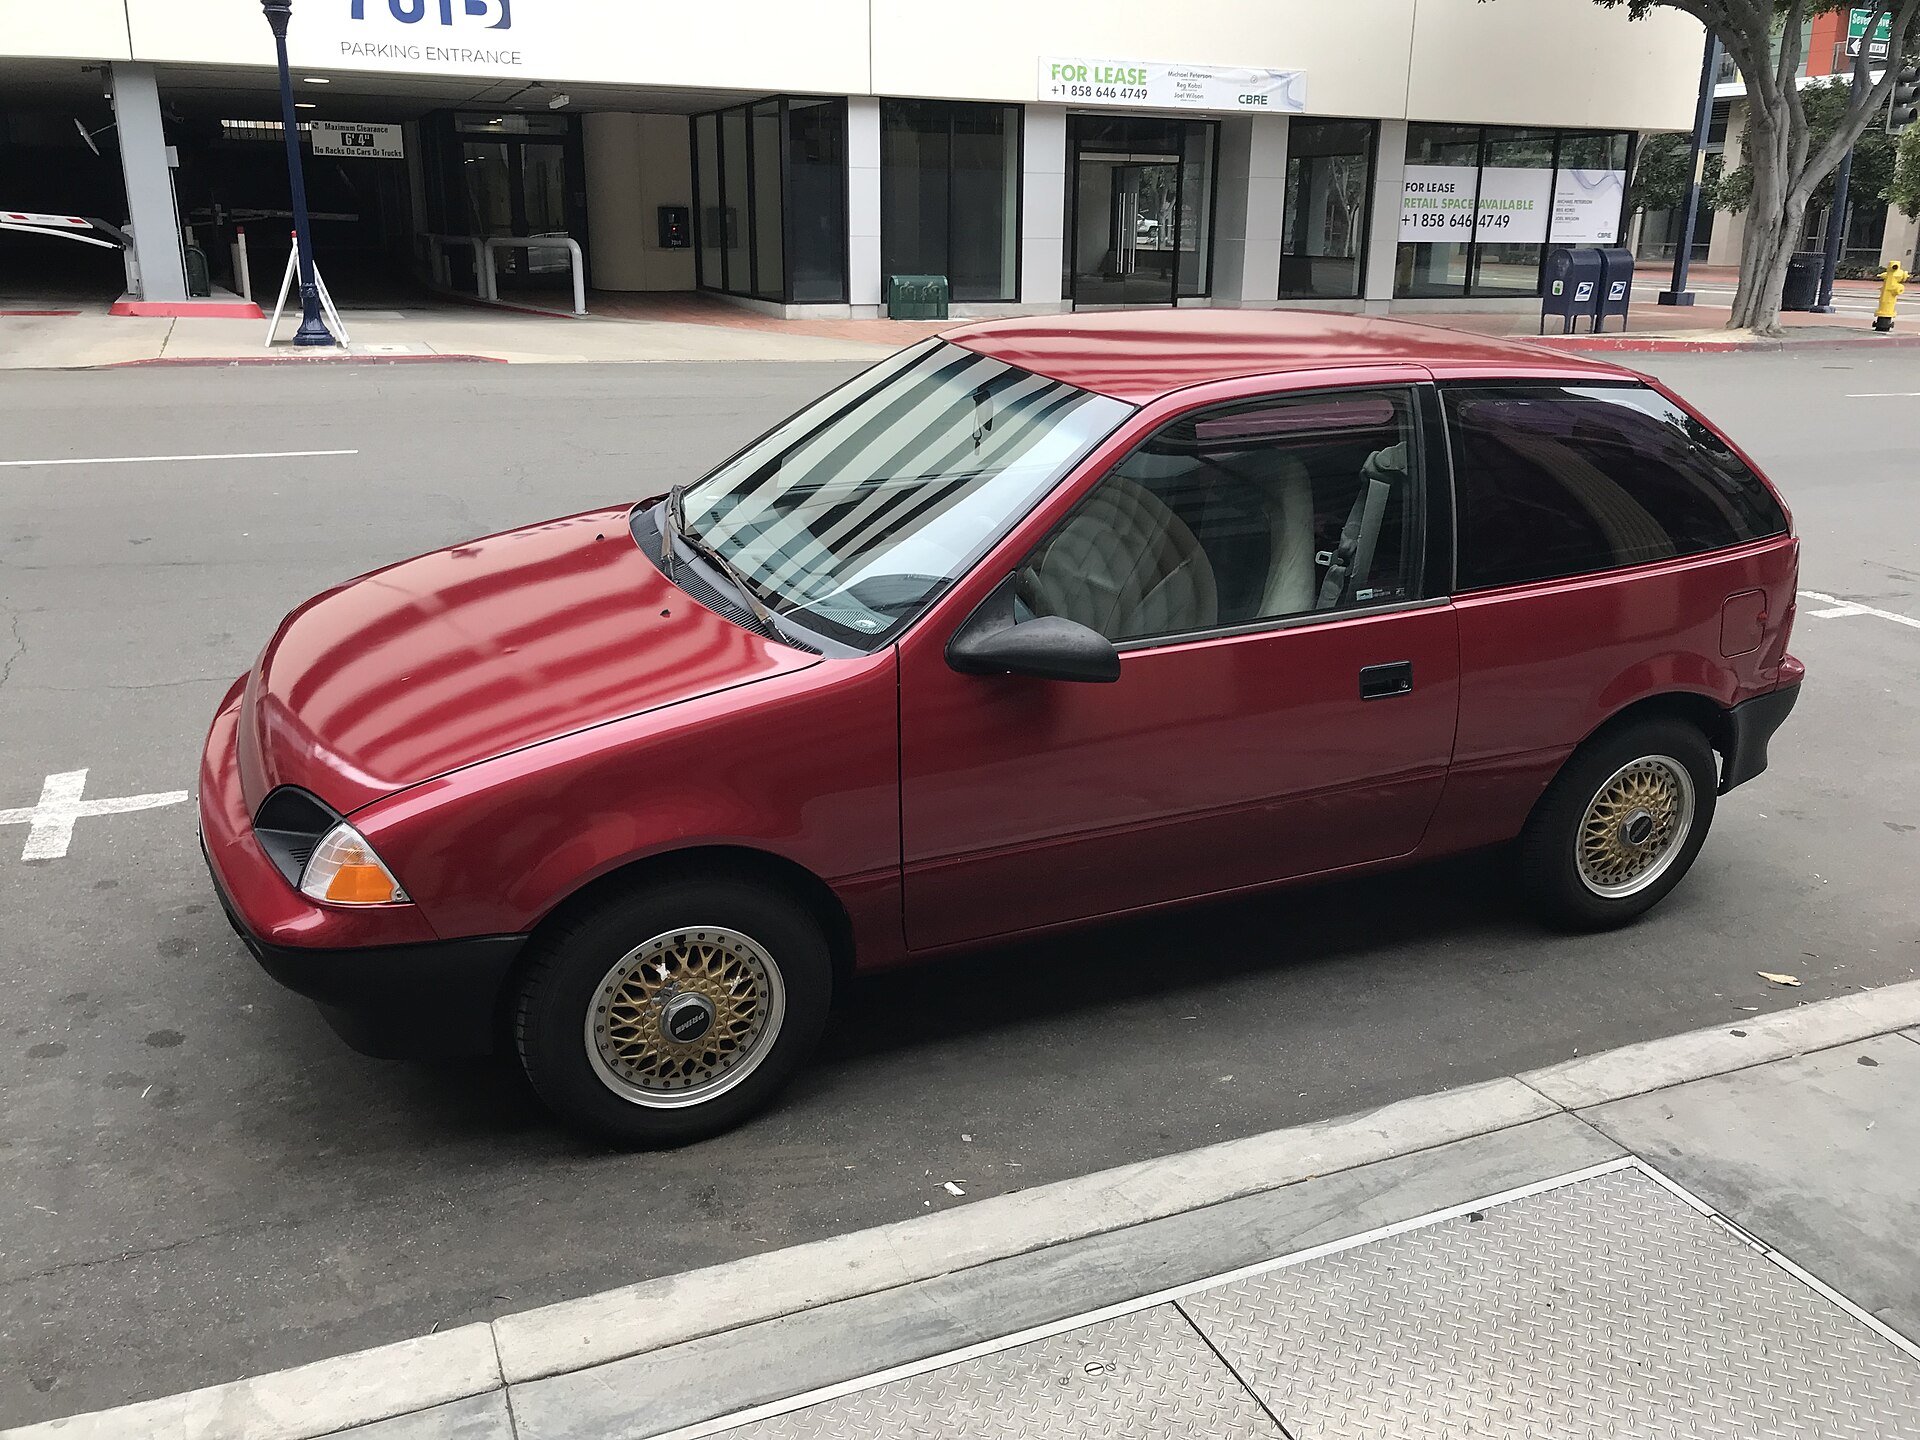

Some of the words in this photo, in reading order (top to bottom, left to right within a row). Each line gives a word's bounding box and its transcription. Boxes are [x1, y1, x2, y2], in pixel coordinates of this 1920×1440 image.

[341, 41, 420, 60] PARKING
[426, 46, 522, 65] ENTRANCE
[1051, 64, 1087, 82] FOR
[1094, 66, 1147, 86] LEASE
[1051, 84, 1066, 95] +1
[1071, 85, 1092, 97] 858
[1095, 86, 1116, 98] 646
[1120, 87, 1148, 99] 4749
[1238, 94, 1268, 105] CBRE
[324, 123, 355, 132] Maximum
[356, 124, 388, 133] Clearance
[345, 133, 355, 146] 6'
[314, 146, 324, 154] No
[325, 146, 345, 155] Racks
[346, 147, 355, 155] On
[356, 148, 371, 156] Cars
[381, 149, 402, 157] Trucks
[1405, 182, 1424, 192] FOR
[1426, 183, 1455, 193] LEASE
[1404, 198, 1438, 209] RETAIL
[1441, 198, 1474, 209] SPACE
[1478, 199, 1534, 210] AVAILABLE
[1401, 213, 1417, 227] +1
[1421, 213, 1444, 227] 858
[1449, 213, 1472, 227] 646
[1478, 214, 1510, 228] 4749
